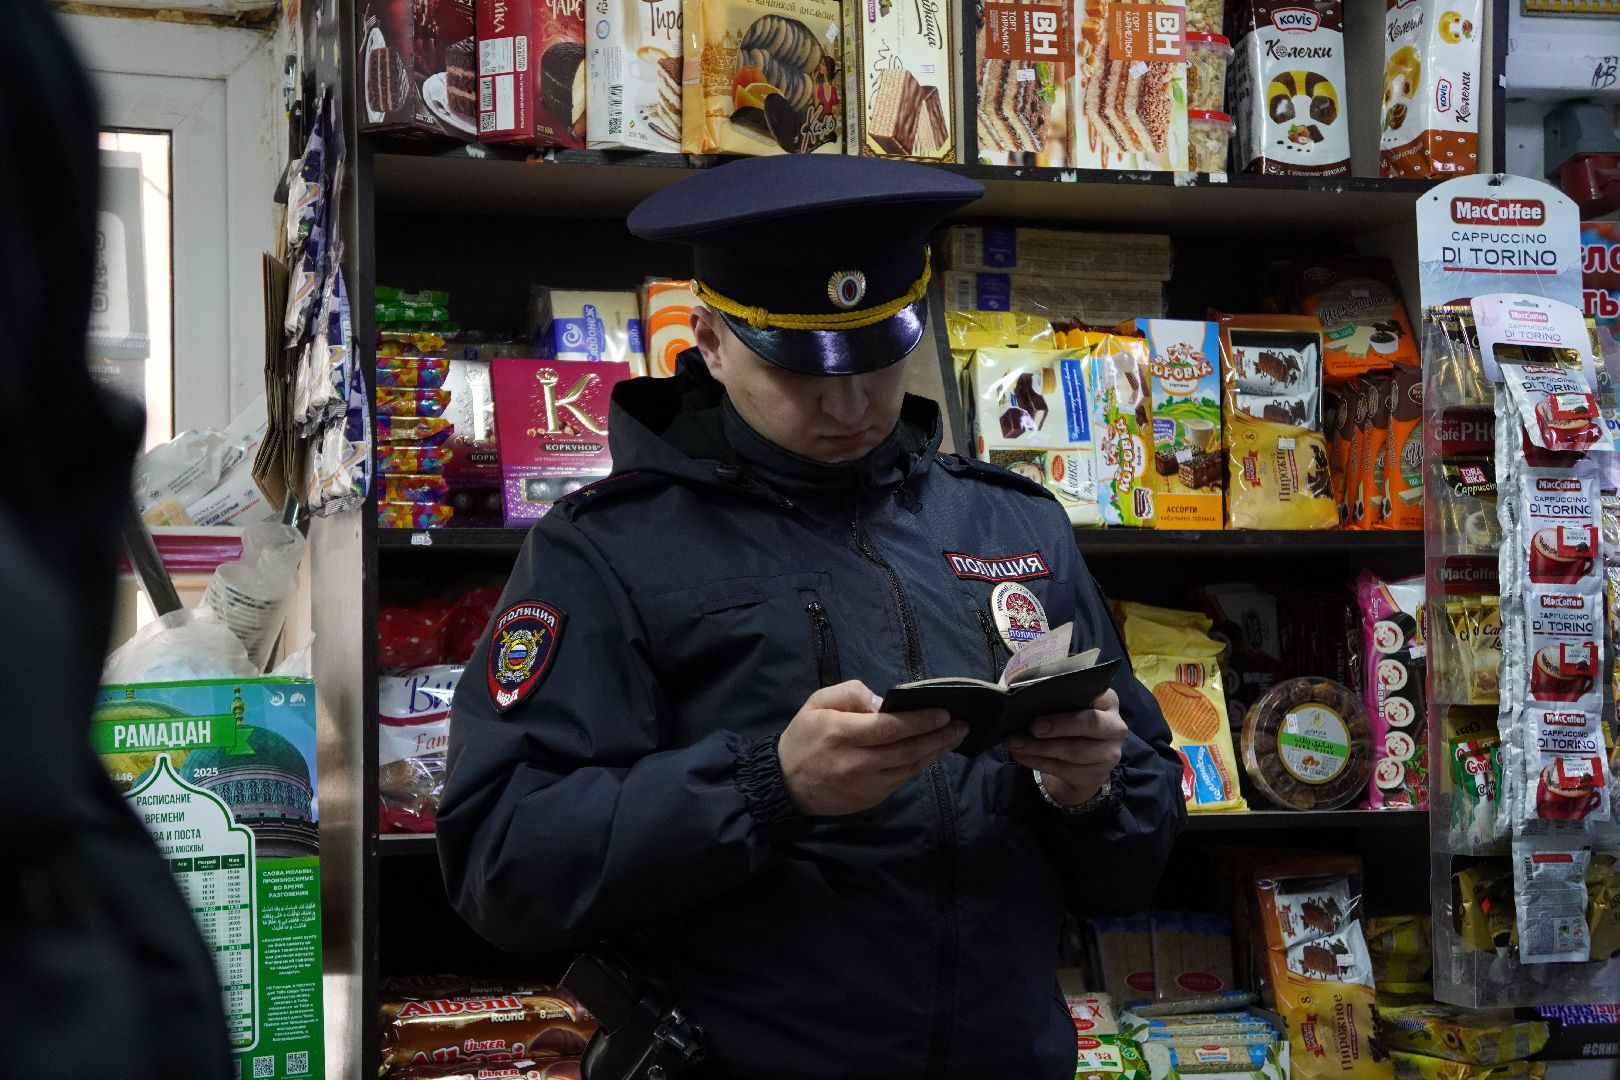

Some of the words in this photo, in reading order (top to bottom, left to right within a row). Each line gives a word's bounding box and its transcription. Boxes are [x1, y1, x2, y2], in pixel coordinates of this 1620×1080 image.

[1132, 12, 1140, 33] ТОРТ
[1001, 11, 1010, 55] ТИРАМИСУ
[1032, 12, 1058, 55] BH
[1155, 12, 1180, 55] BH
[1265, 39, 1333, 60] Колечки
[1456, 71, 1471, 123] Колечки
[1455, 201, 1543, 221] MacCoffee
[1442, 247, 1461, 263] DI
[1470, 248, 1557, 267] TORINO
[1504, 330, 1516, 339] DI
[1520, 332, 1562, 342] TORINO
[545, 444, 599, 452] КОРКУНОВ
[1544, 504, 1592, 514] TORINO
[950, 557, 1045, 578] ПОЛИЦИЯ
[498, 607, 557, 629] ПОЛИЦИЯ
[1548, 622, 1594, 632] TORINO
[114, 721, 211, 749] РАМАДАН
[1551, 739, 1596, 749] TORINO
[193, 768, 219, 782] 2025
[136, 793, 192, 807] РАСПИСАНИЕ
[144, 811, 185, 824] ВРЕМЕНИ
[166, 832, 174, 842] И
[175, 829, 201, 842] ПОСТА
[176, 845, 204, 855] МОСКВЫ
[397, 995, 523, 1018] Albeni
[491, 1012, 525, 1022] Round
[1334, 992, 1354, 1071] Пирожное
[464, 1039, 506, 1052] ÜLKER
[478, 1068, 521, 1079] ÜLKER
